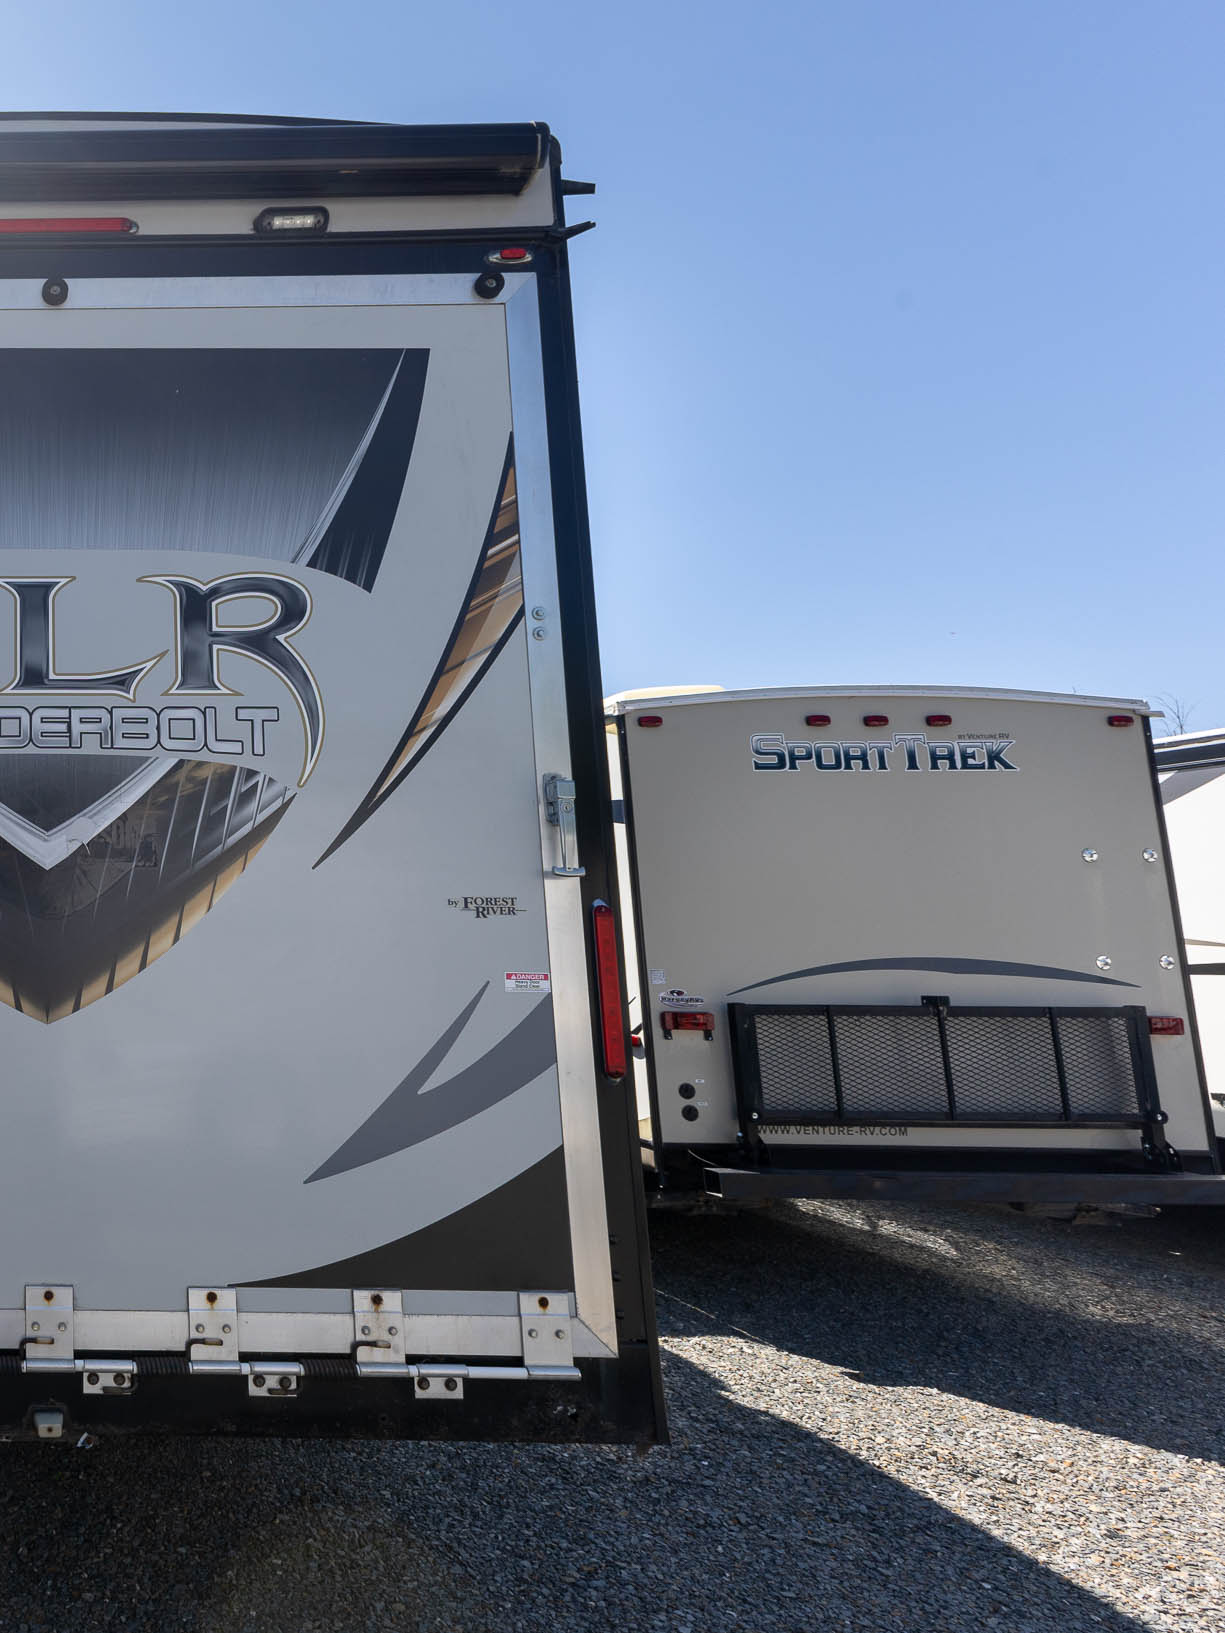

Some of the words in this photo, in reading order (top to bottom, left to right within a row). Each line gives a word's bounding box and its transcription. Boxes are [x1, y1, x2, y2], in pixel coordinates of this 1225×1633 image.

[447, 898, 459, 908] by
[462, 896, 517, 909] FOREST
[475, 906, 517, 919] RIVER
[758, 1125, 908, 1136] WWW.VENTURE-RV.COM
